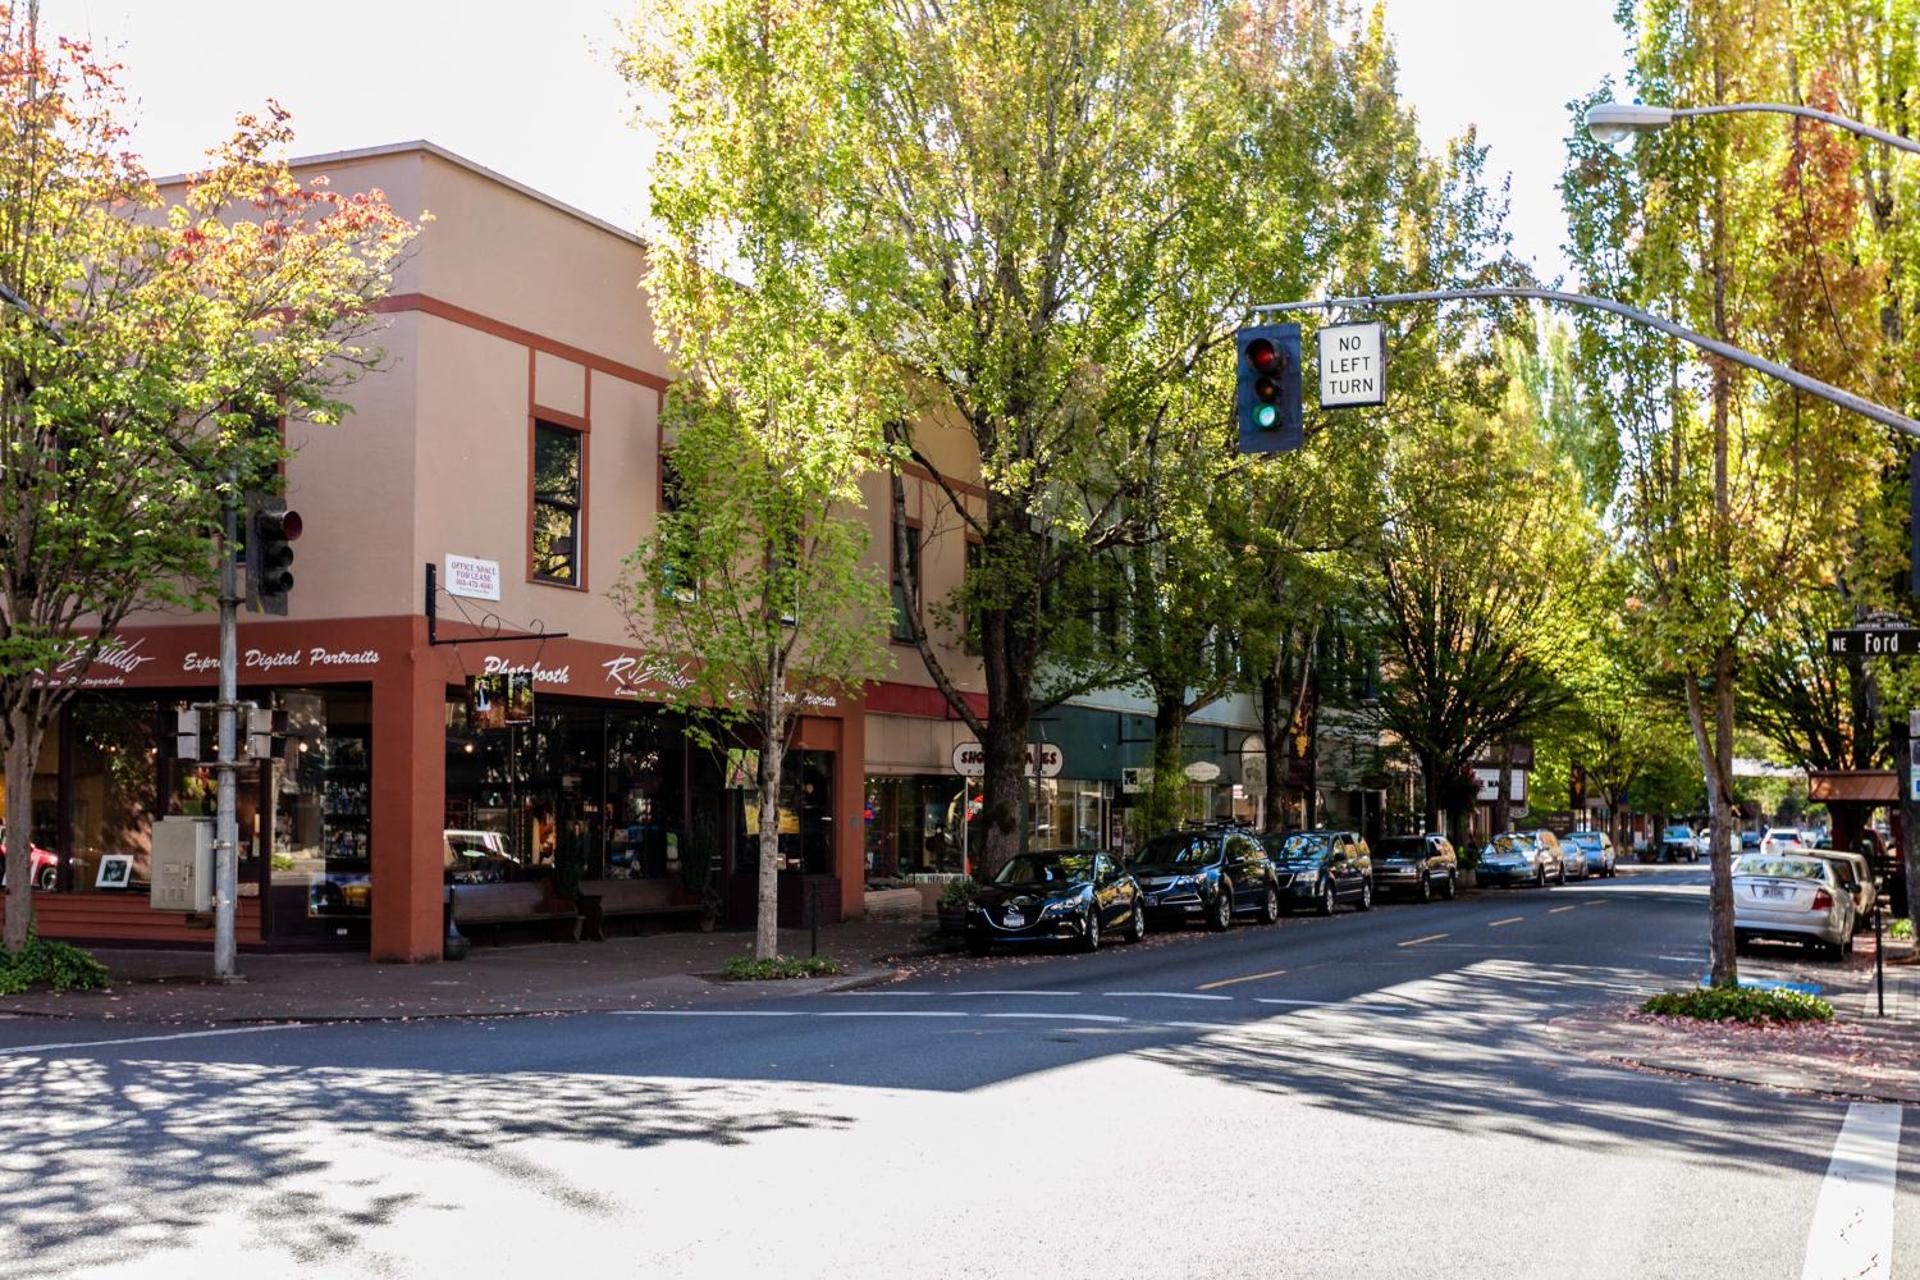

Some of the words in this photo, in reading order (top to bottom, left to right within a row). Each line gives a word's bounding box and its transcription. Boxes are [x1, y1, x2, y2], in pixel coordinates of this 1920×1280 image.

[1339, 336, 1361, 351] NO
[1330, 356, 1371, 374] LEFT
[1330, 378, 1373, 395] TURN
[451, 561, 474, 572] OFFICE
[476, 565, 496, 575] SPACE
[456, 570, 470, 579] FOR
[471, 573, 491, 582] LEASE
[1832, 637, 1847, 652] NE
[1865, 633, 1899, 653] Ford
[183, 652, 238, 673] Expr
[245, 649, 301, 671] Digital
[309, 647, 380, 666] Portraits
